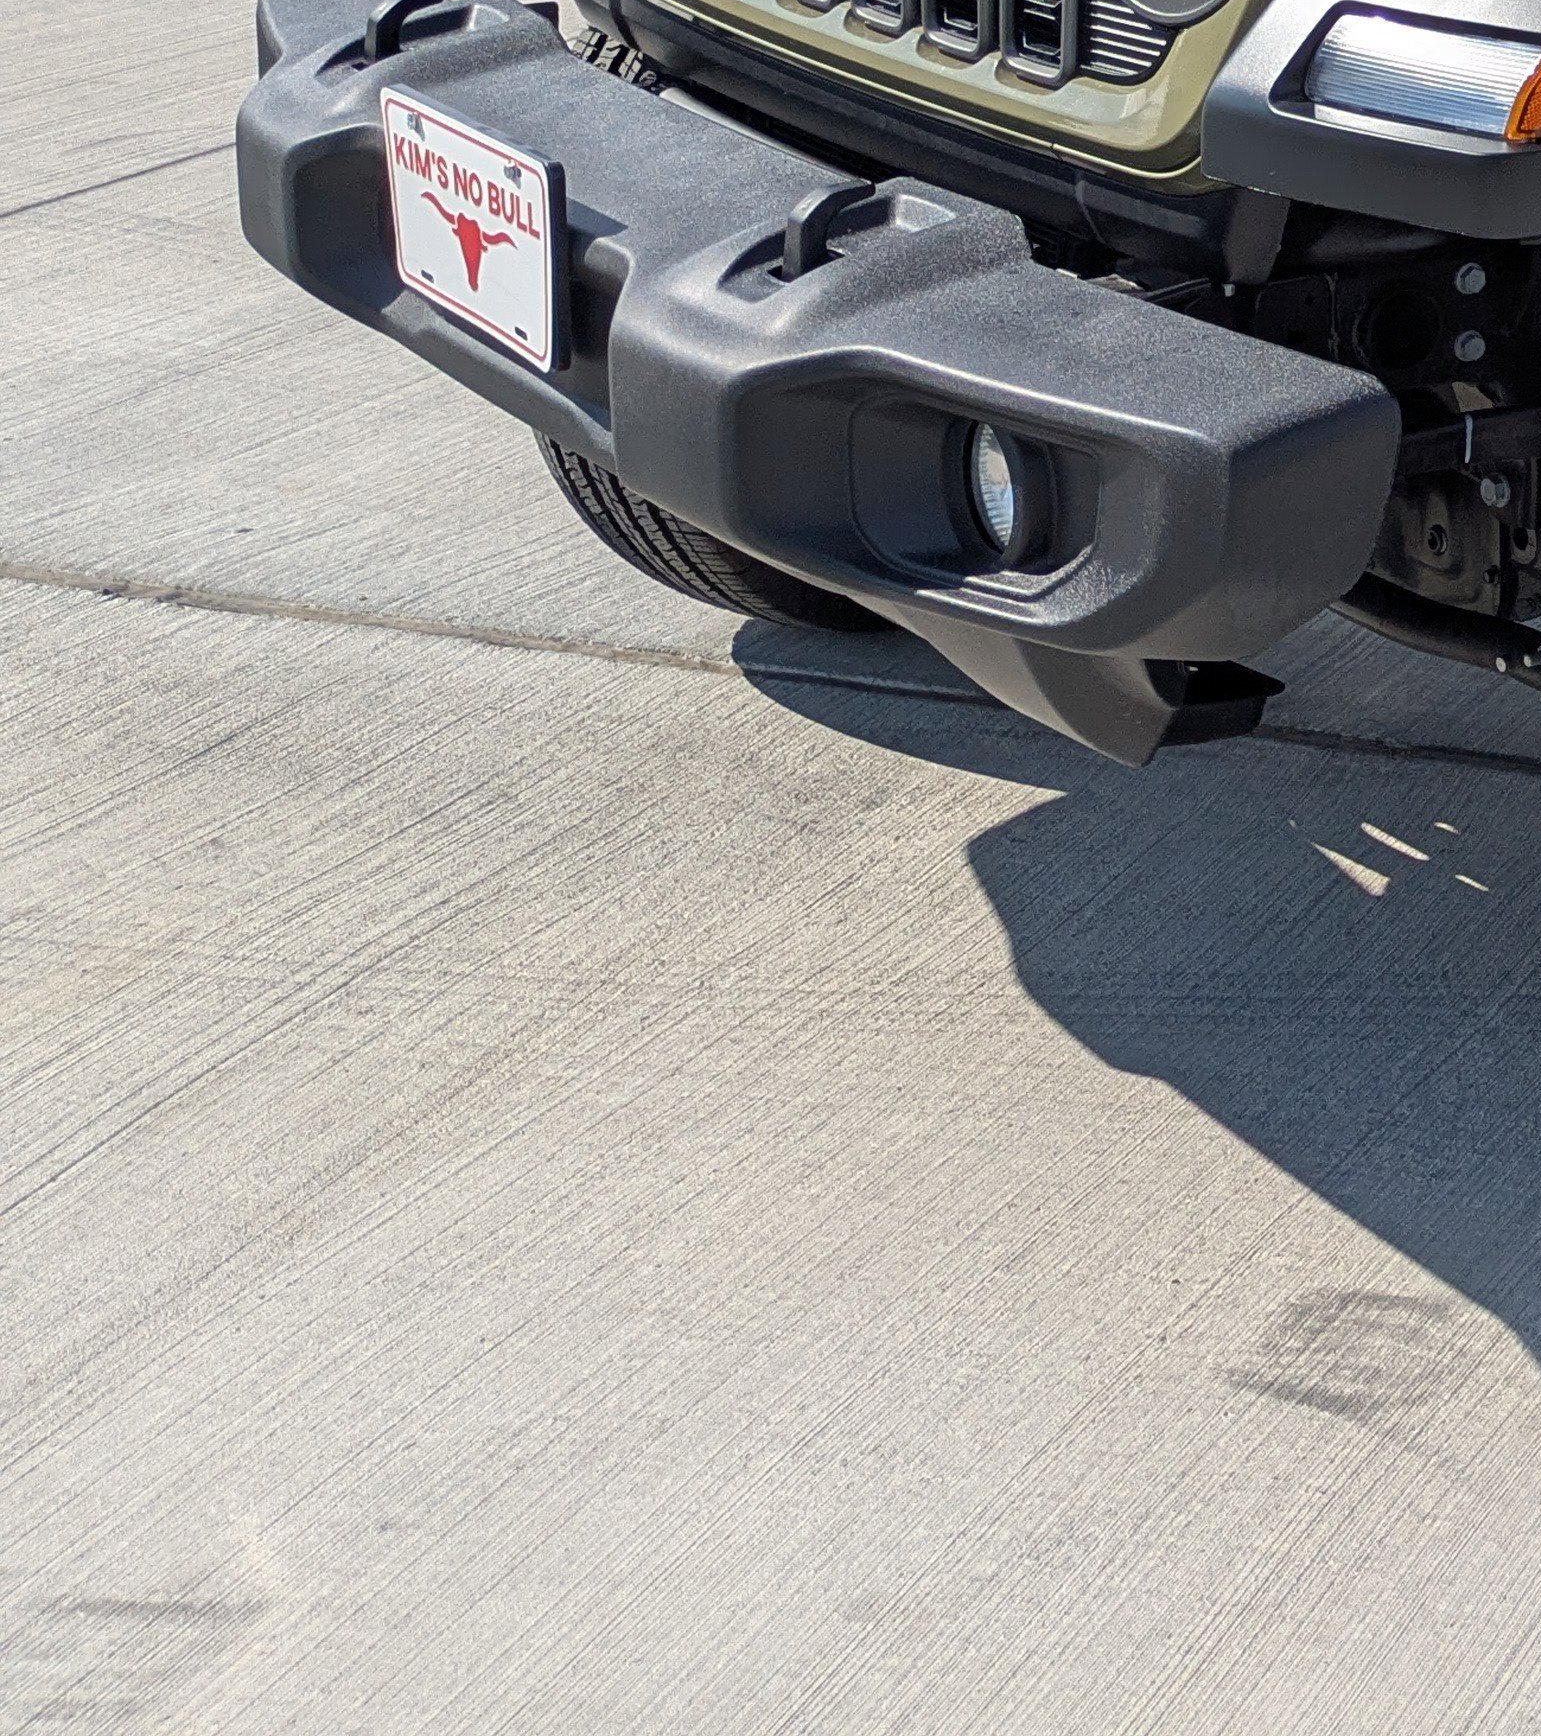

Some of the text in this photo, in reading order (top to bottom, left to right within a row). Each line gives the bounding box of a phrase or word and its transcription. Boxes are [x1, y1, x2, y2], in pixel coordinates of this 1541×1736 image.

[393, 132, 541, 240] KIM'S NO BULL
